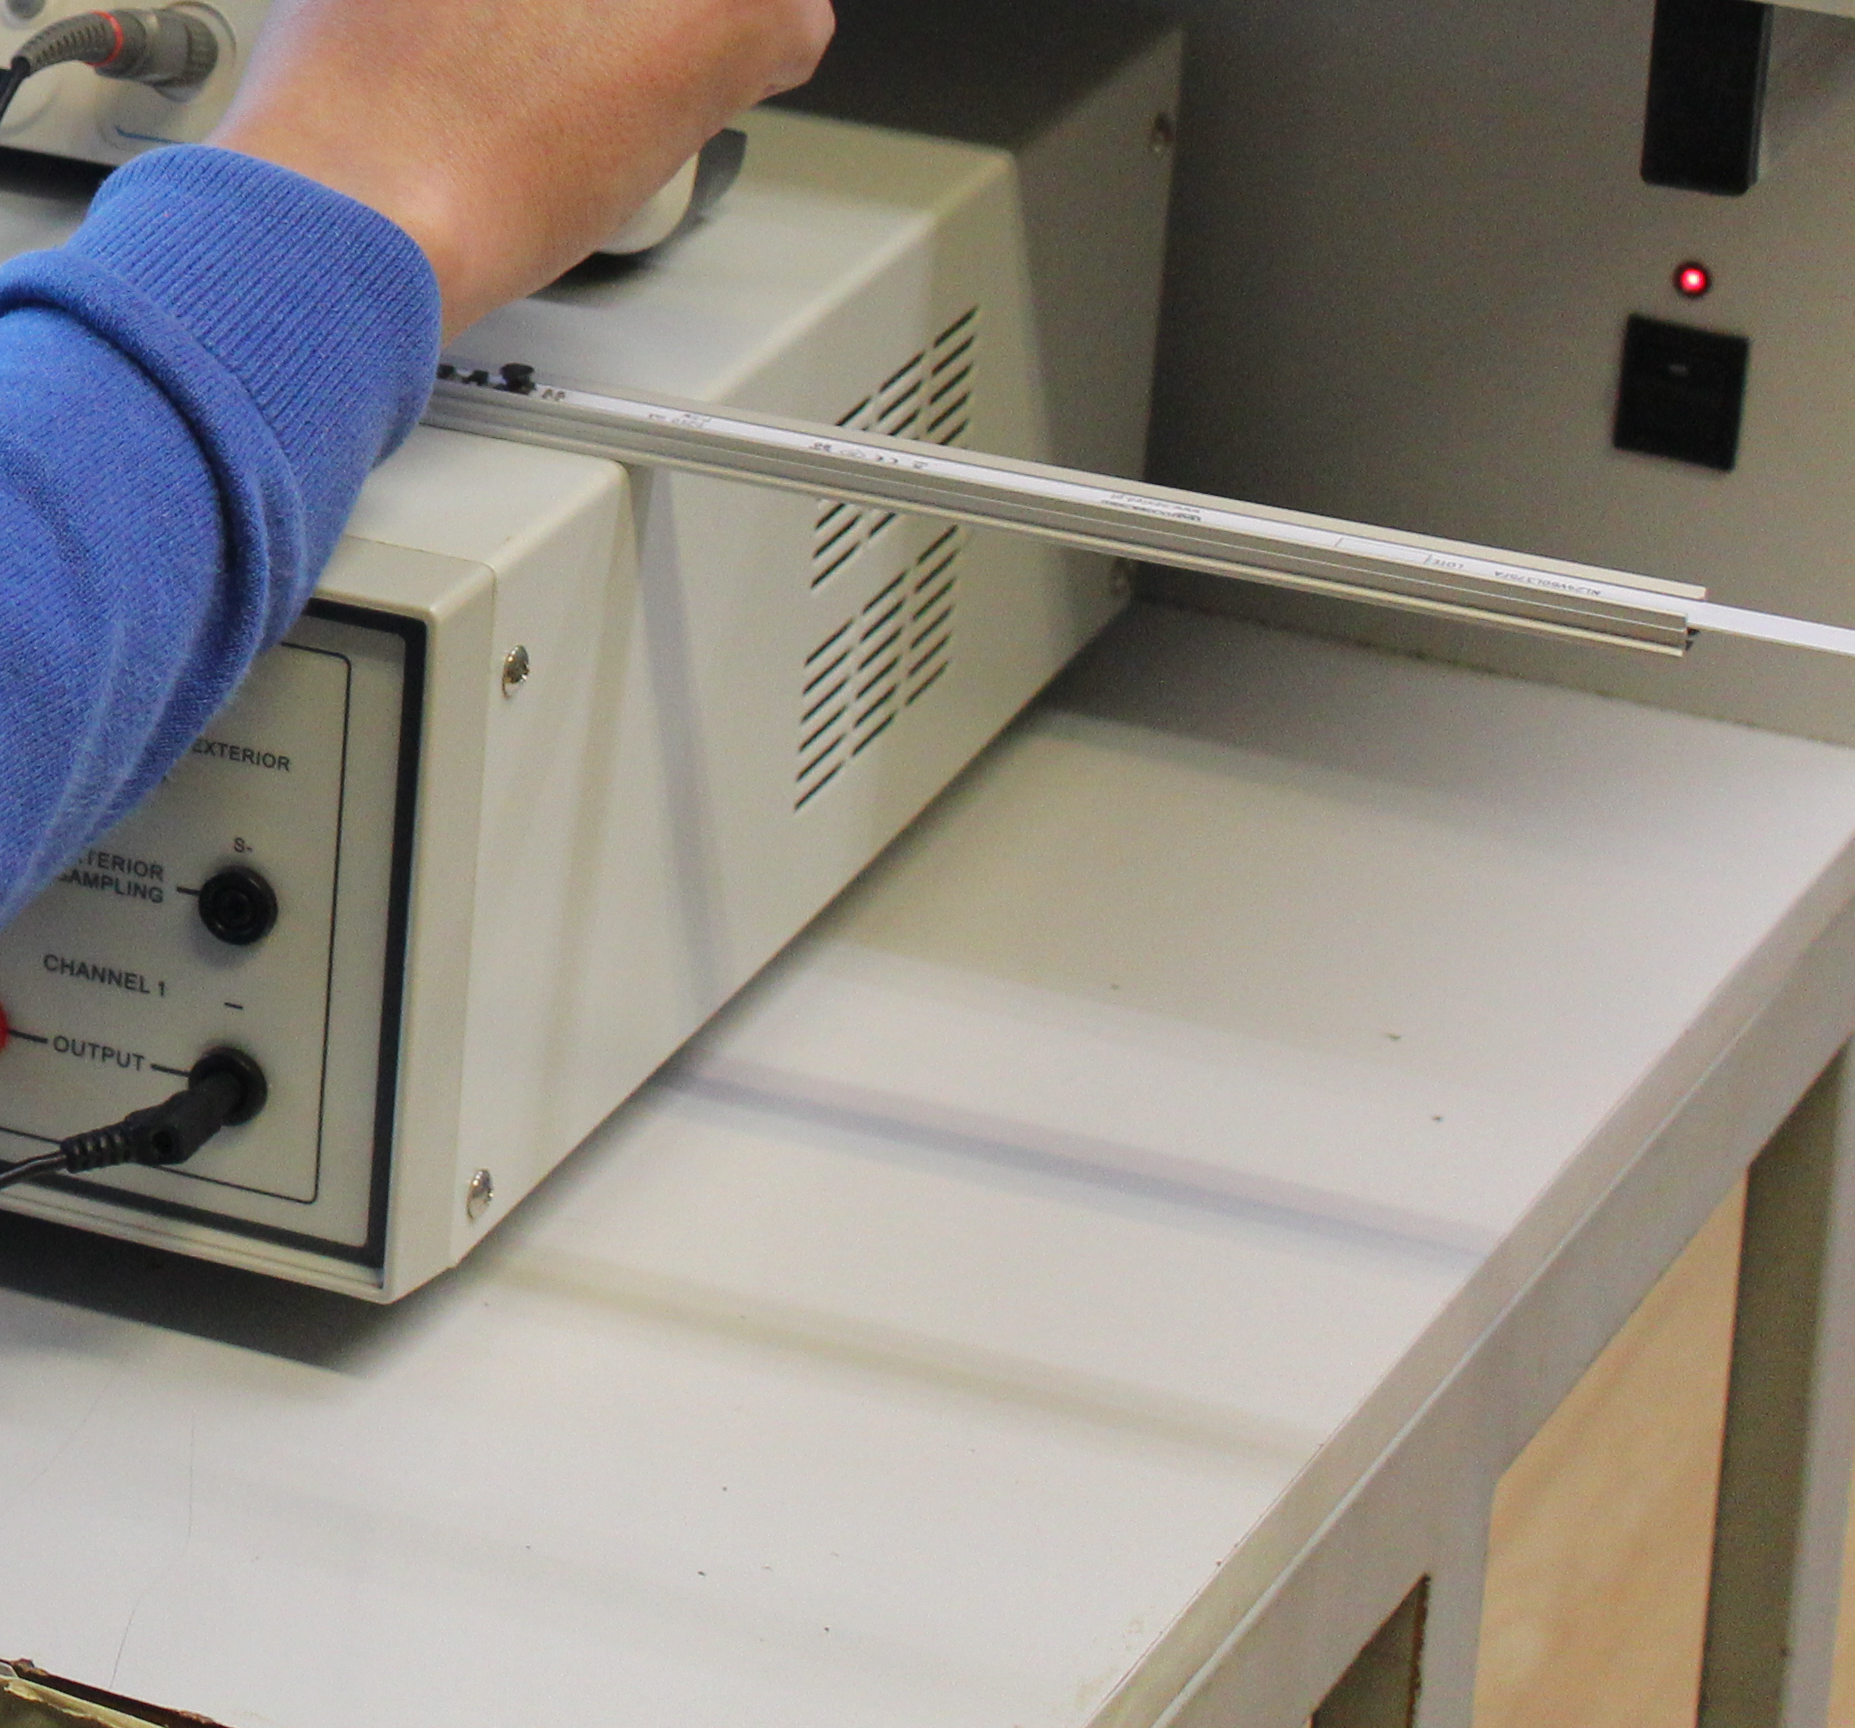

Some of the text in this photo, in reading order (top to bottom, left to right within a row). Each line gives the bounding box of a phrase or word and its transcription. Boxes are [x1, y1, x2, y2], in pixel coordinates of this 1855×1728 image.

[192, 738, 291, 772] EXTERIOR
[79, 849, 163, 883] TERIOR
[43, 953, 166, 998] CHANNEL 1
[53, 1034, 146, 1072] OUTPUT
